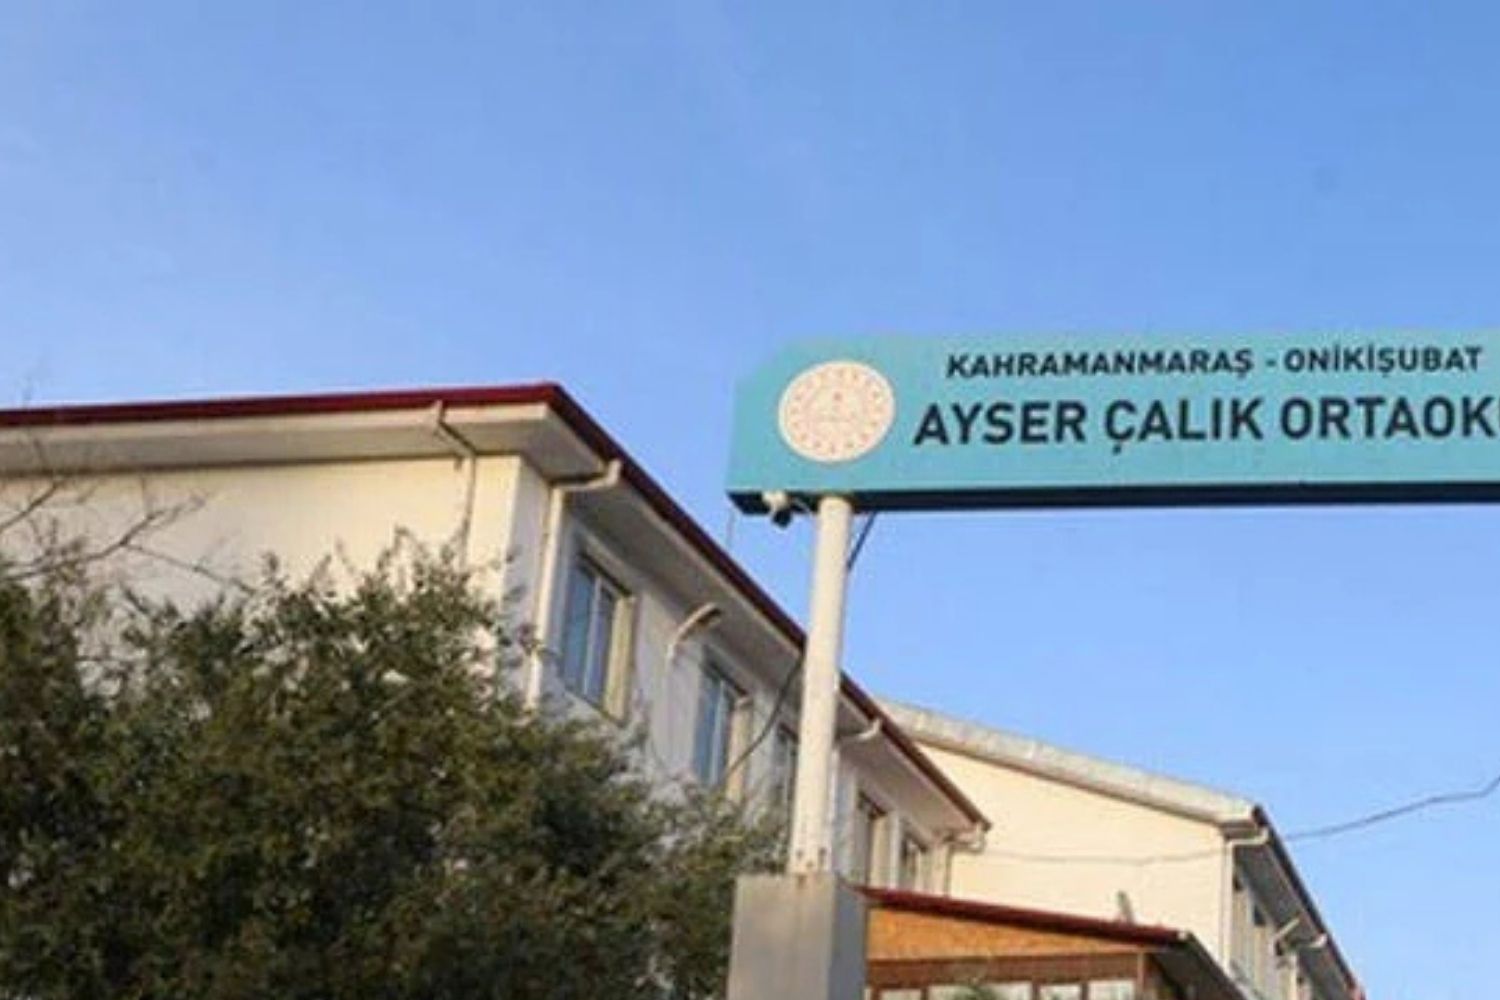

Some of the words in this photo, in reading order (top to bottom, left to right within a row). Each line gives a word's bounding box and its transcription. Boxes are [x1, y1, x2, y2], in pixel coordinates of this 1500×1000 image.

[947, 351, 1252, 378] KAHRAMANMARAŞ
[1284, 346, 1481, 373] ONİKİŞUBAT
[913, 400, 1087, 446] AYSER
[1104, 399, 1263, 454] ÇALIK
